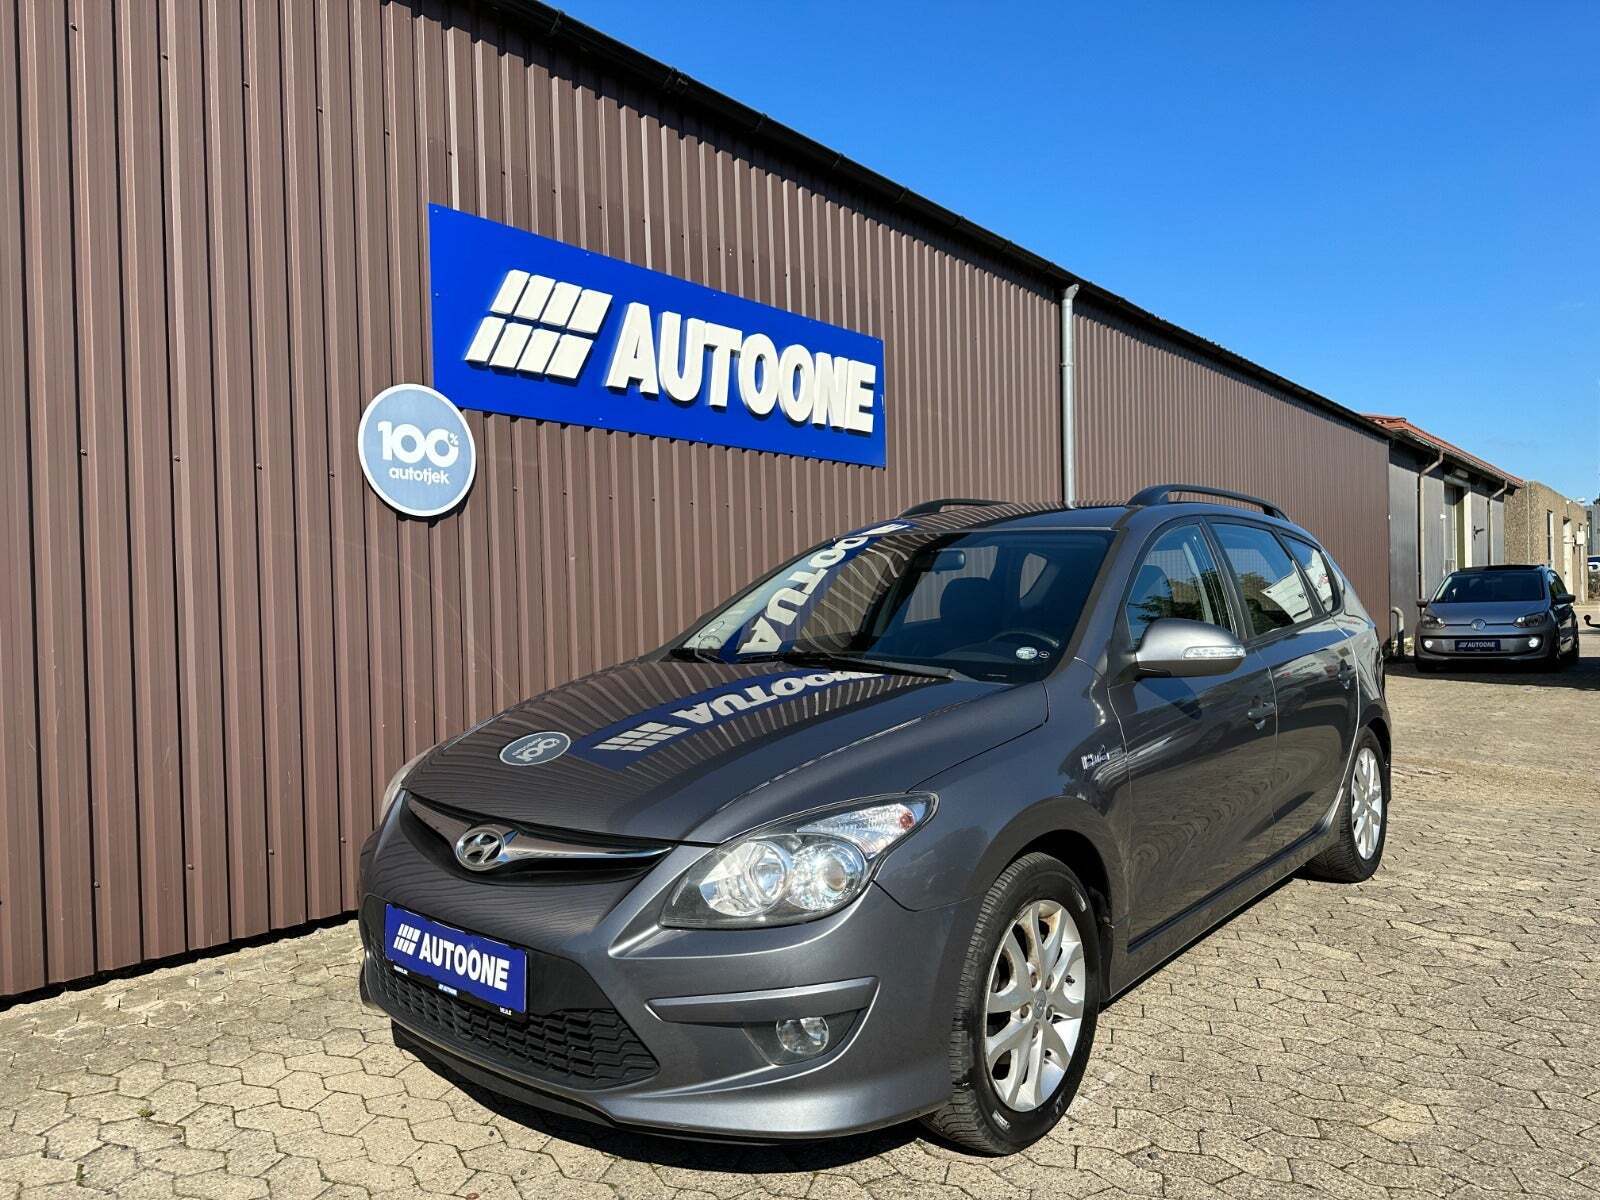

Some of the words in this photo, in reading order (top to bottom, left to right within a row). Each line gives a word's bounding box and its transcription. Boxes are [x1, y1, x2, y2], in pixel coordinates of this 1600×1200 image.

[605, 302, 876, 433] AUTOONE
[388, 466, 450, 485] autotjek
[419, 932, 510, 992] AUTOONE
